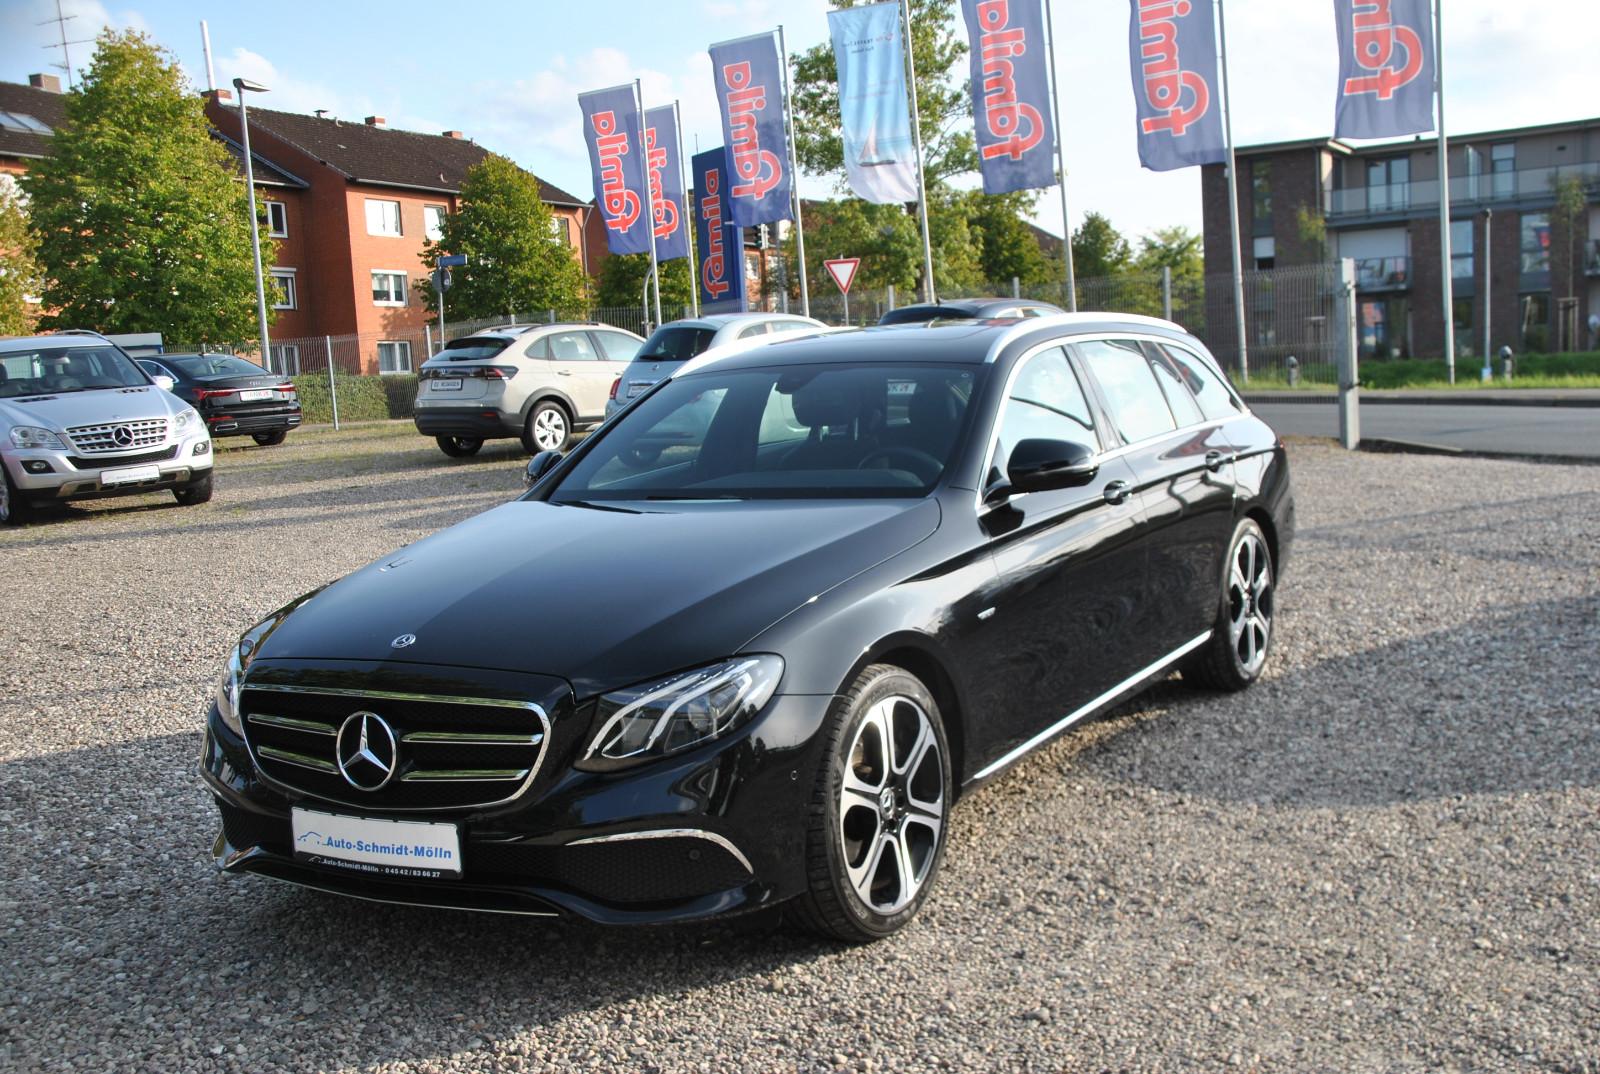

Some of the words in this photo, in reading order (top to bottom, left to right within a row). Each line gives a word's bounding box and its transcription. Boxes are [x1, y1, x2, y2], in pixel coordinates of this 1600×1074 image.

[702, 169, 730, 299] famila
[327, 836, 452, 859] Auto-Schmidt-Mölln
[323, 858, 379, 873] Auto-Schmidt-Mölln
